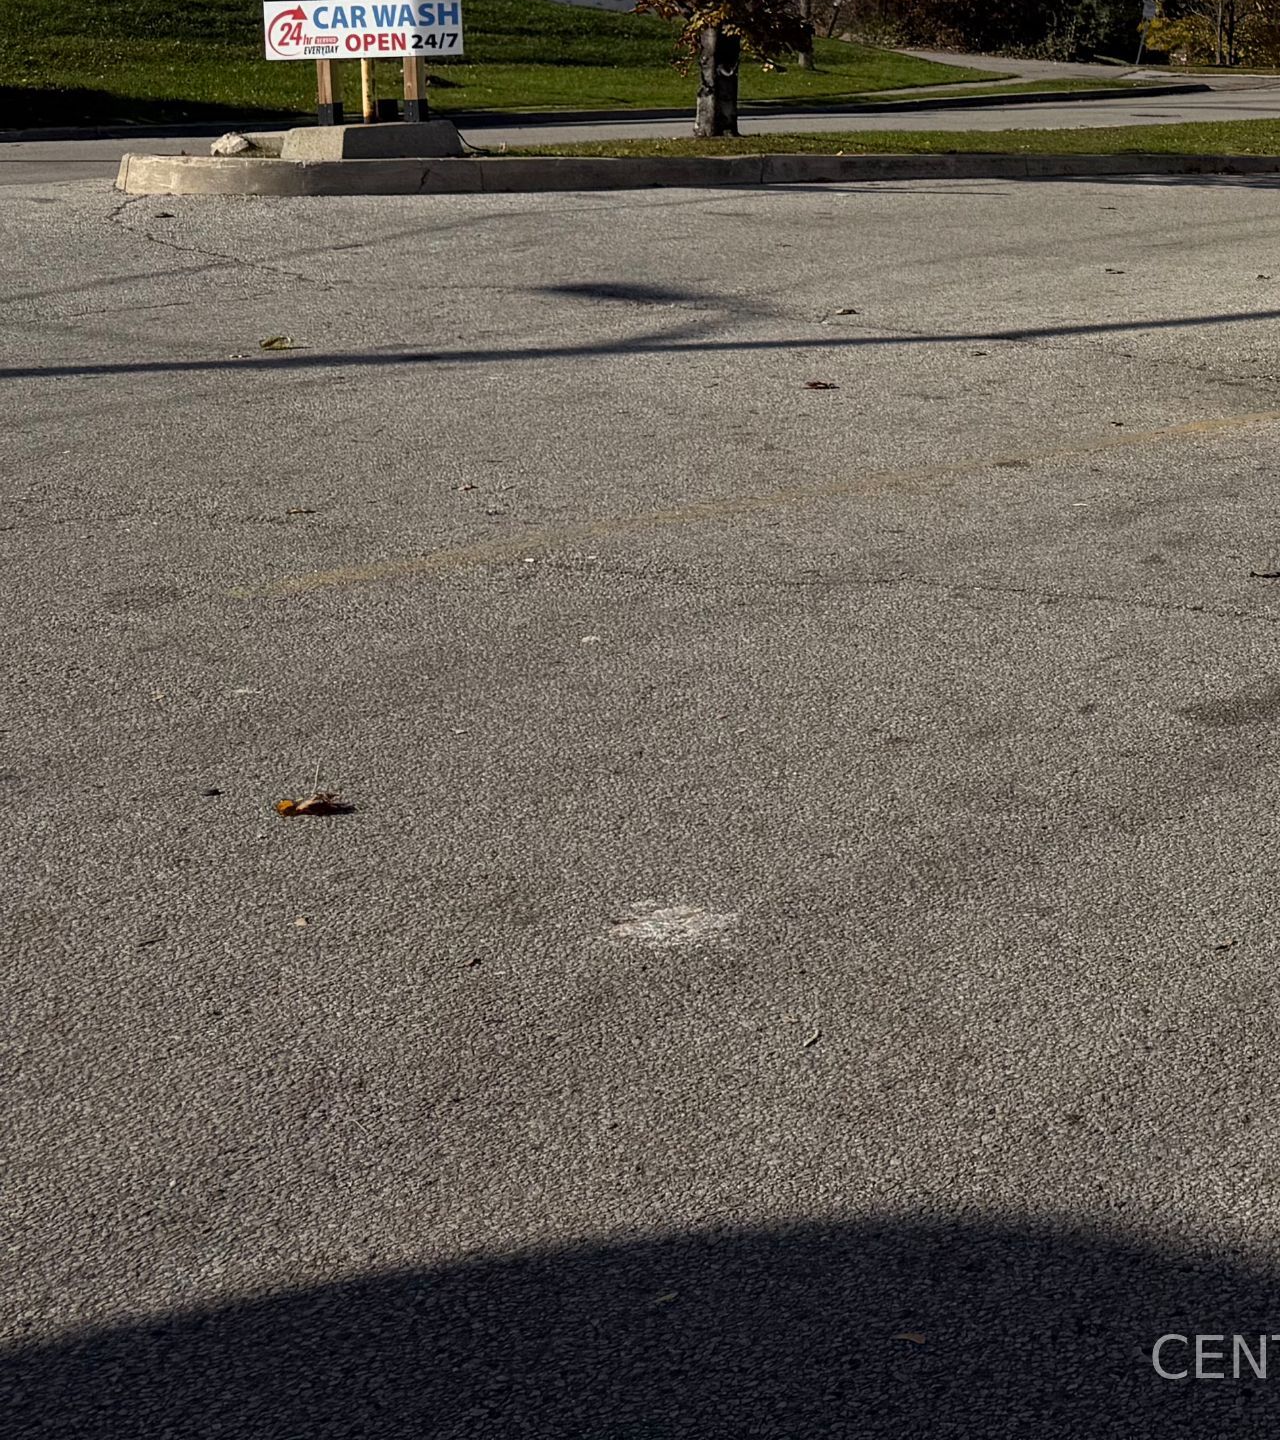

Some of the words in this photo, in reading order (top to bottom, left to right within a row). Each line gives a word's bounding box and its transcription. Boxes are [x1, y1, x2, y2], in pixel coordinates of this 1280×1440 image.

[313, 5, 367, 30] CAR
[372, 2, 459, 28] WASH
[278, 22, 302, 46] 24
[303, 34, 313, 46] hr
[345, 32, 406, 52] OPEN
[411, 33, 459, 50] 24/7
[304, 45, 339, 56] EVERYDAY
